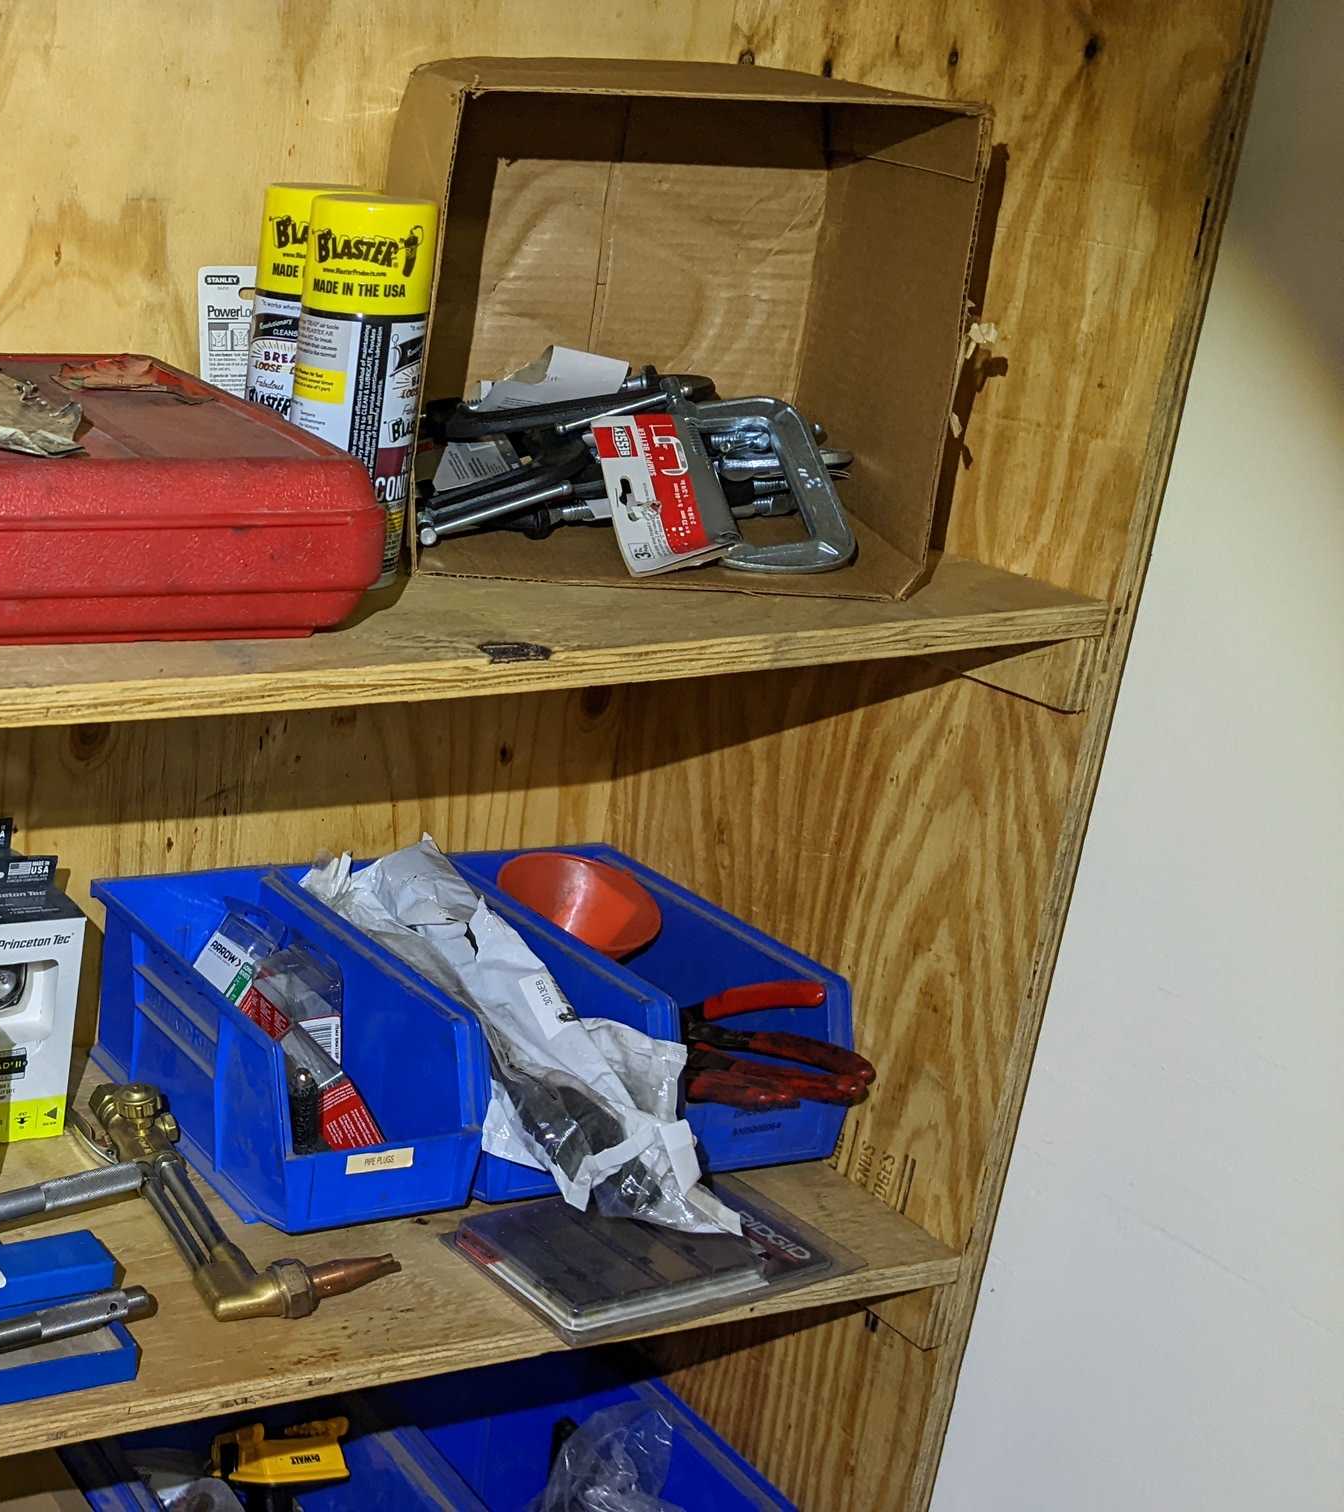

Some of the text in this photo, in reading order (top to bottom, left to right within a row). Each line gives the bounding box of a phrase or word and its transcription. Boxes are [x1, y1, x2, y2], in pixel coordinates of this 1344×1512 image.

[272, 262, 299, 278] MADE
[207, 276, 238, 284] STANLEY
[313, 278, 406, 298] MADE IN THE USA
[207, 305, 253, 317] PowerLo
[361, 395, 369, 415] CLEAN
[614, 426, 631, 458] BESSEY
[638, 428, 656, 476] SIMPLY BETTER
[31, 866, 49, 875] USA
[53, 934, 71, 945] Tec
[209, 939, 237, 965] ARROW
[377, 1155, 395, 1165] PLUGS
[738, 1210, 812, 1260] RIDGID
